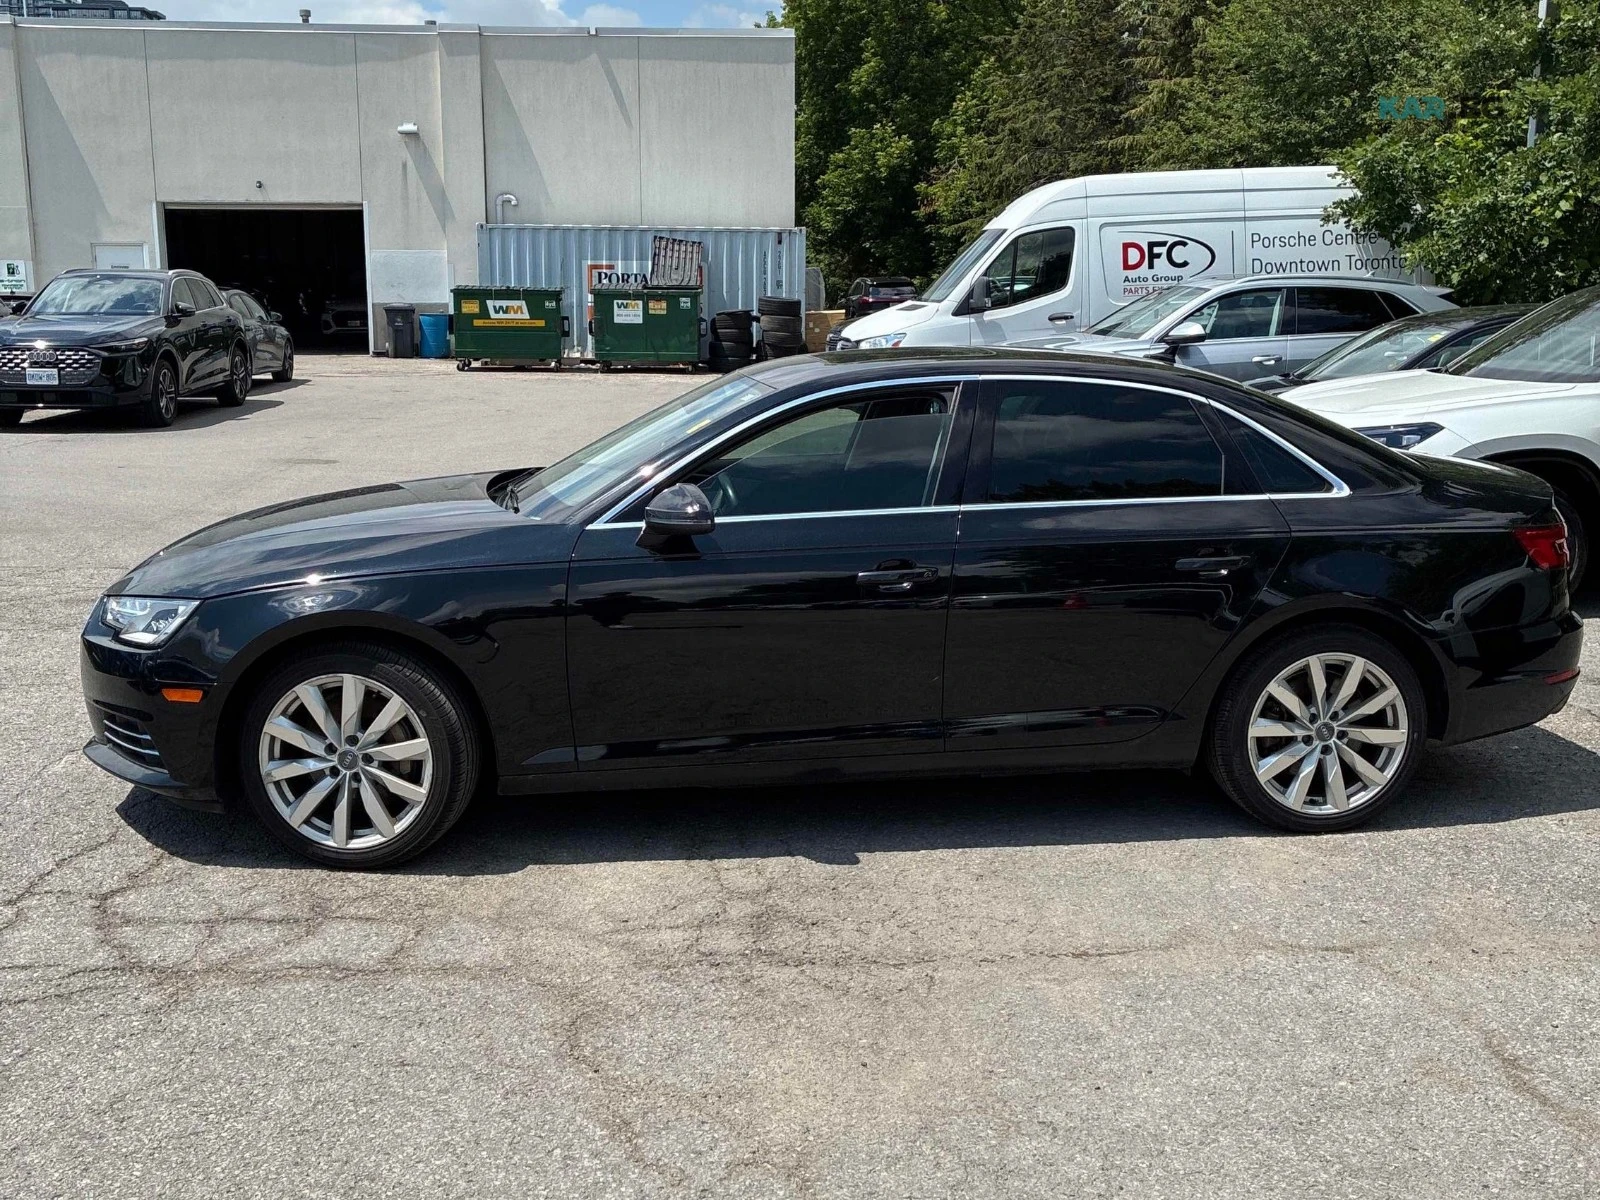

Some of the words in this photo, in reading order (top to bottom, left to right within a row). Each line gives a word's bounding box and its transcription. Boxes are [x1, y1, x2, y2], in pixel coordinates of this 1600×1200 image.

[1251, 231, 1317, 249] Porsche
[1322, 229, 1377, 246] Centre
[1122, 240, 1190, 271] DFC
[1251, 253, 1341, 275] Downtown
[1123, 275, 1149, 283] Auto
[1151, 274, 1184, 283] Group
[1123, 286, 1150, 296] PARTS
[493, 305, 525, 314] WM
